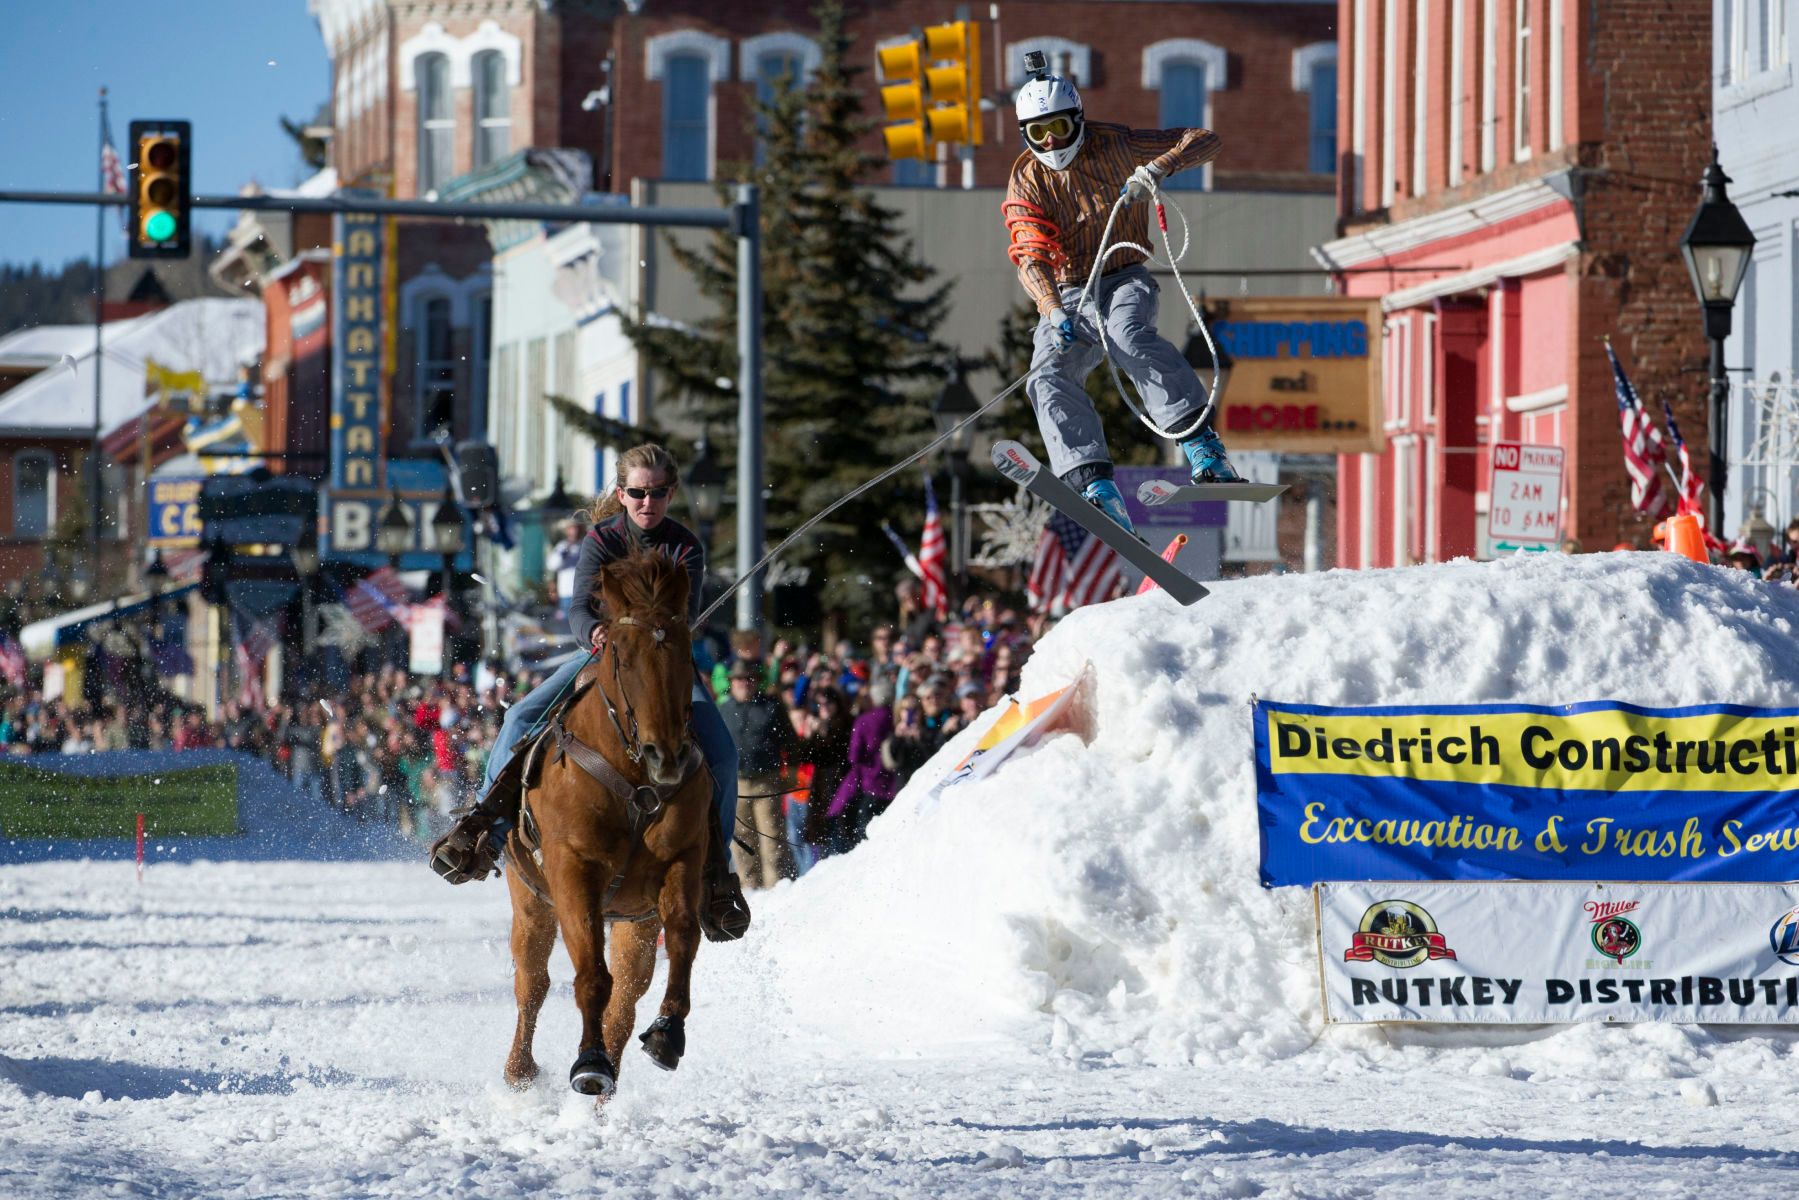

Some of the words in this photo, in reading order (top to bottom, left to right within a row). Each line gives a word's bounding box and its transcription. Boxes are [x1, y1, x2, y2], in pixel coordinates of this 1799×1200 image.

[1213, 320, 1367, 358] SHIPPING
[1270, 372, 1309, 391] and
[1496, 447, 1518, 467] NO
[1523, 450, 1561, 466] PARKING
[1495, 507, 1511, 525] TO
[1278, 723, 1500, 765] Diedrich
[1521, 725, 1798, 775] Constructi
[1299, 801, 1523, 851] Excavation
[1534, 815, 1568, 853] &
[1581, 816, 1706, 859] Trash
[1583, 899, 1640, 921] Miller
[1365, 936, 1432, 949] RUTKEY
[1351, 975, 1522, 1007] RUTKEY
[1546, 975, 1798, 1007] DISTRIBUTI
